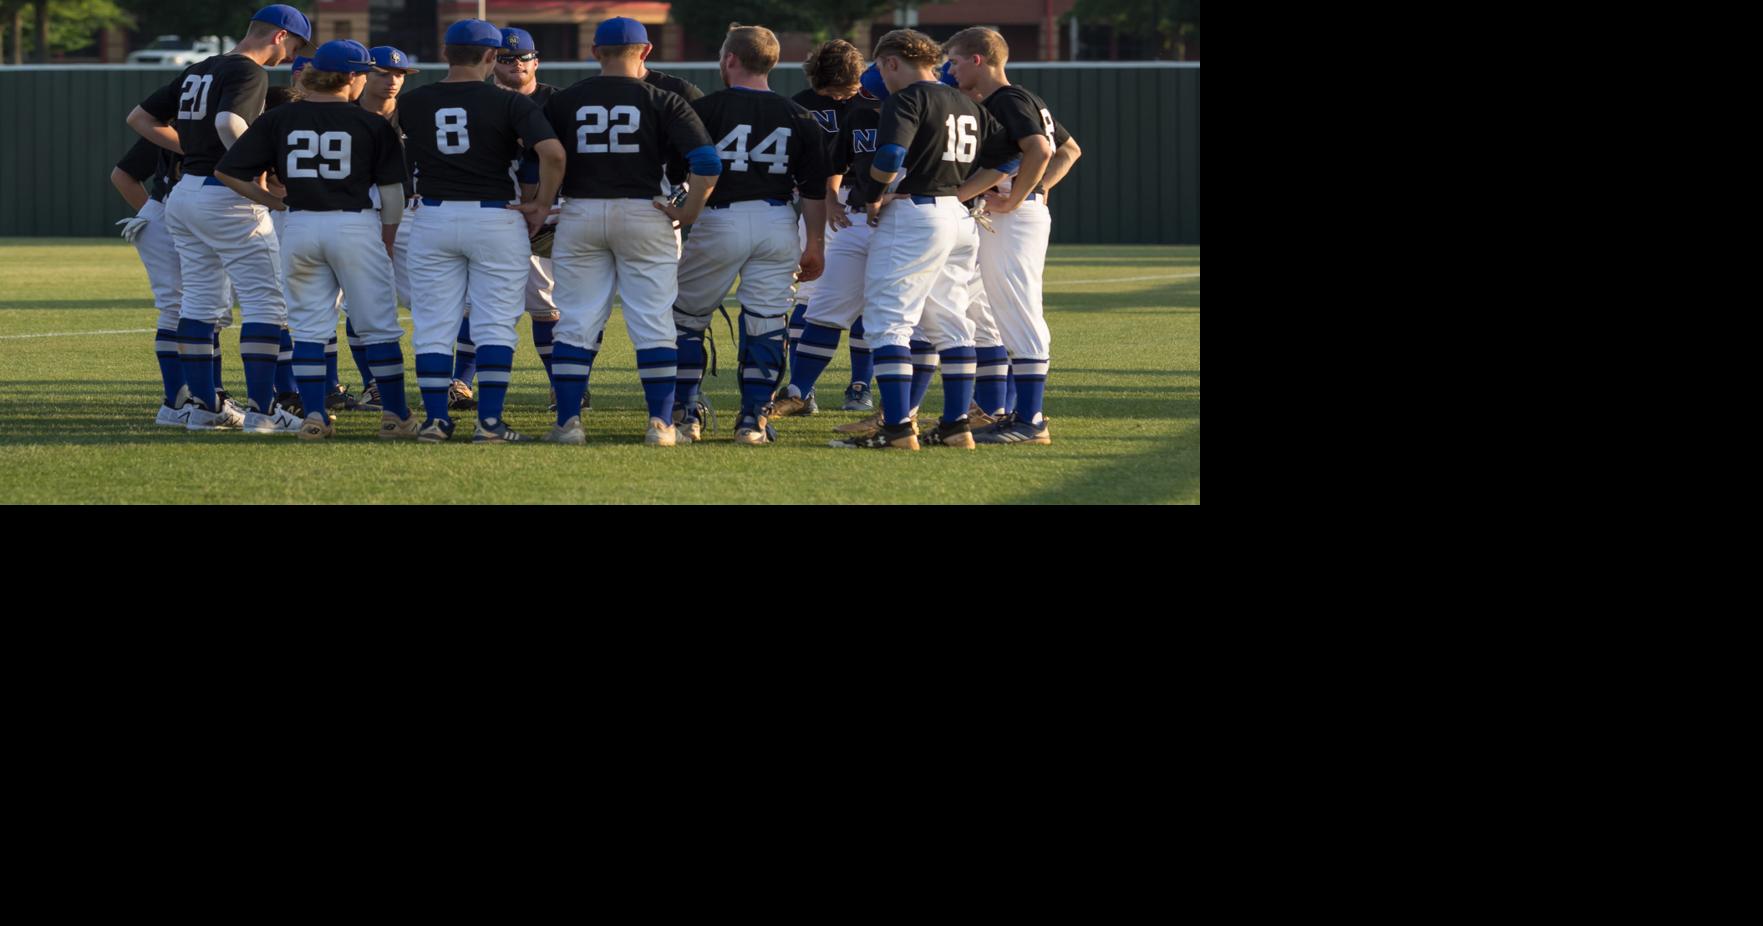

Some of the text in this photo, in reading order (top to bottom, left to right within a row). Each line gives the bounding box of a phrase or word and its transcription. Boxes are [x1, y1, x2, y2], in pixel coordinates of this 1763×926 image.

[178, 74, 213, 120] 20
[435, 107, 470, 154] 8
[576, 105, 641, 153] 22
[716, 124, 792, 174] 44
[852, 128, 878, 153] N
[942, 113, 978, 163] 16
[287, 129, 352, 179] 29
